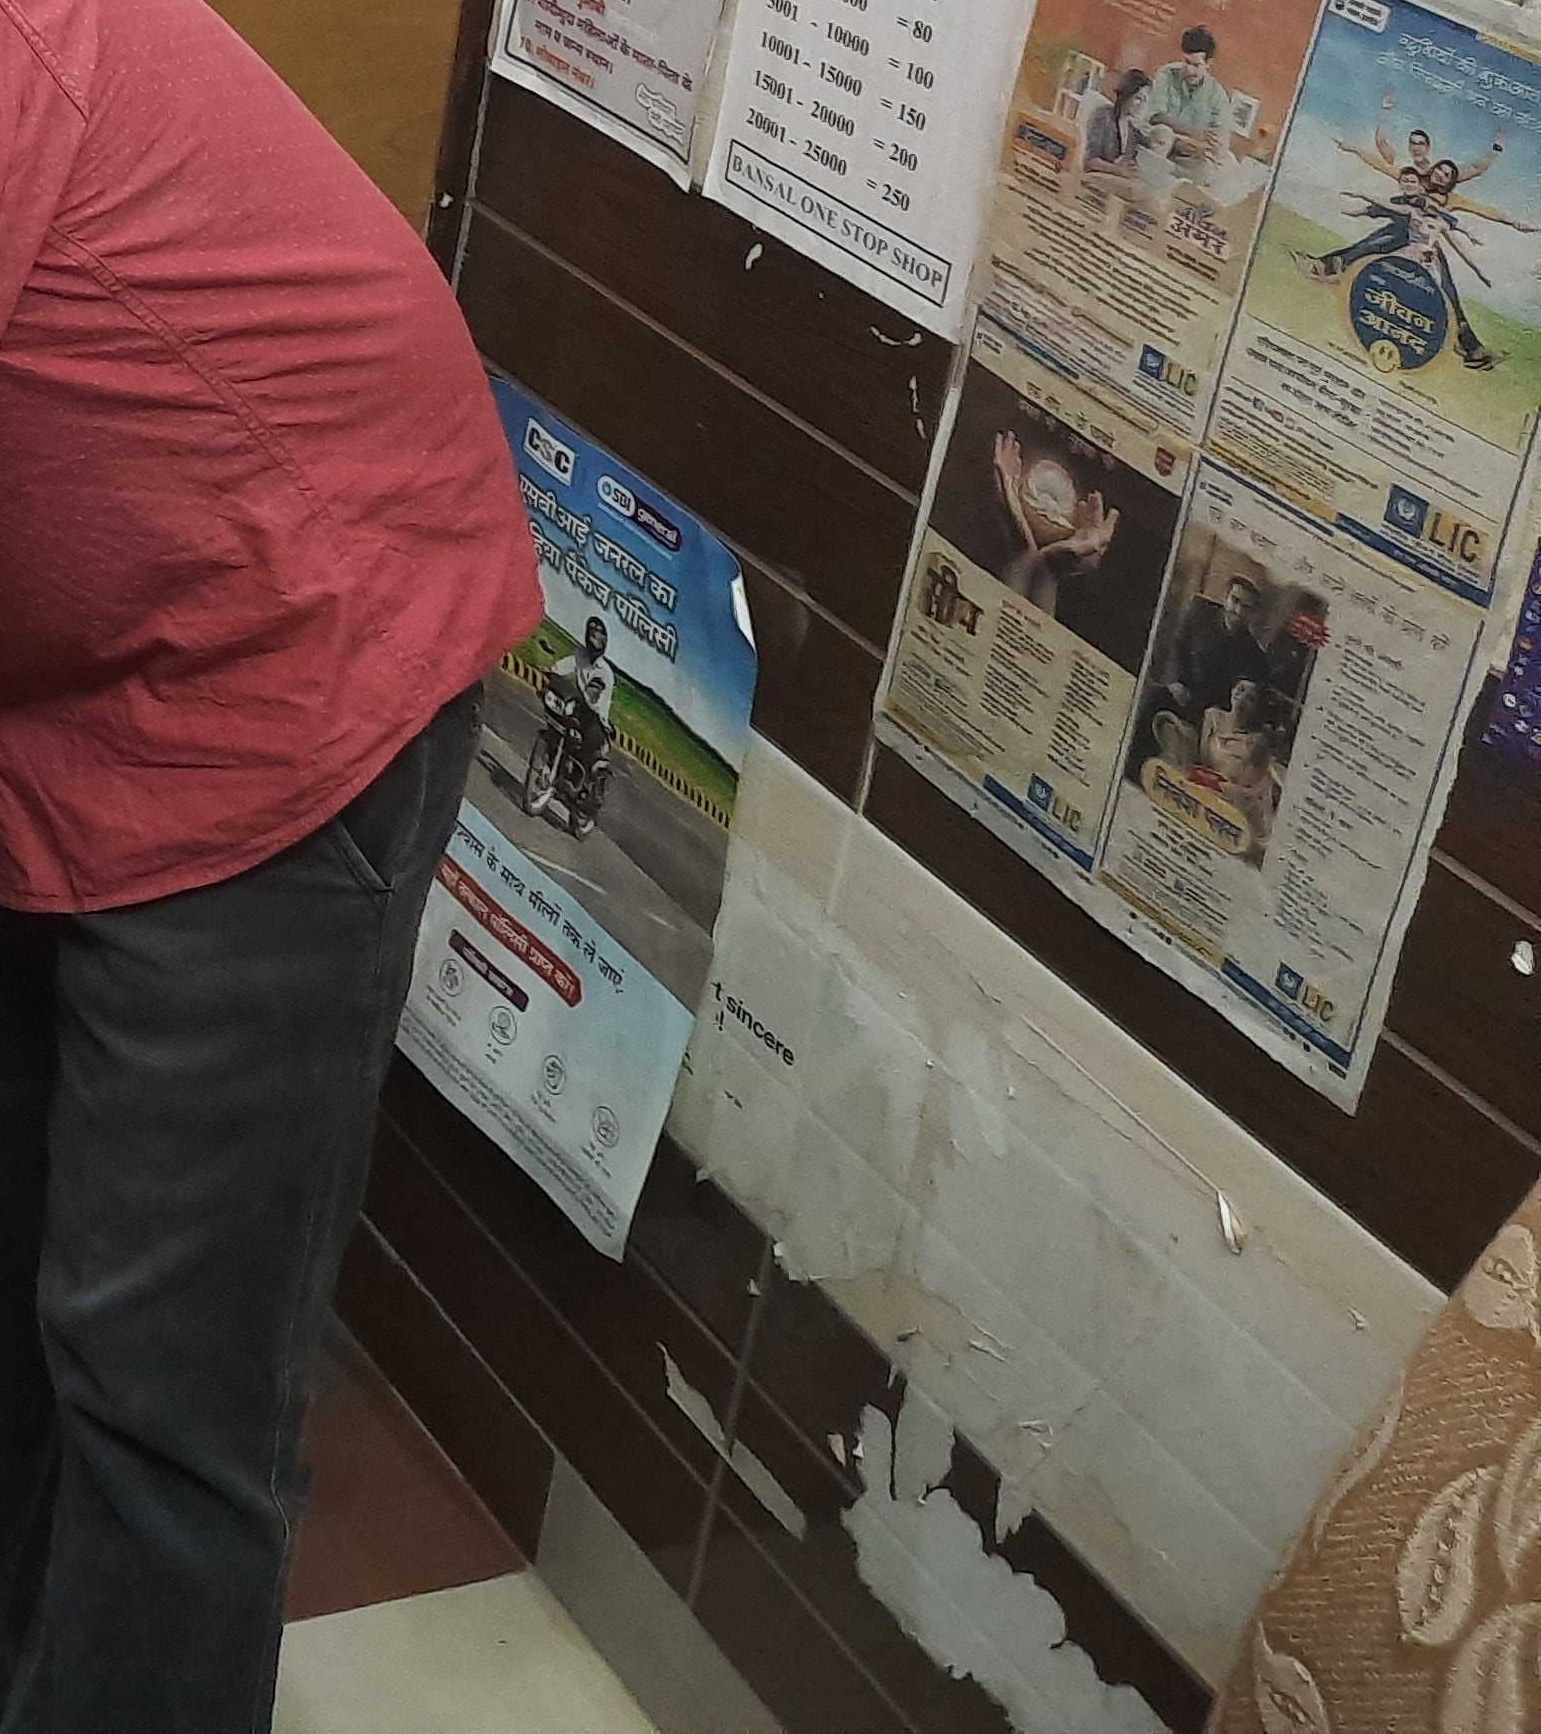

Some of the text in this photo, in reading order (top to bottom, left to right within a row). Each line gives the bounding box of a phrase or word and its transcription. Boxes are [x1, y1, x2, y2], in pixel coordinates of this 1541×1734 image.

[825, 22, 871, 57] 10000
[904, 59, 936, 91] 100
[911, 19, 934, 44] 80
[819, 61, 863, 98] 15000
[896, 101, 927, 132] 150
[810, 100, 856, 137] 20000
[887, 141, 919, 172] 200
[802, 138, 848, 176] 25000
[880, 182, 912, 213] 250
[731, 152, 944, 291] BANSAL ONE STOP SHOP
[528, 426, 572, 474] CSC
[612, 488, 680, 544] SBI general
[1428, 512, 1481, 564] LIC
[593, 532, 678, 610] जनरल का
[1051, 801, 1082, 834] LIC
[725, 995, 795, 1067] sincere
[1302, 985, 1335, 1023] LIC
